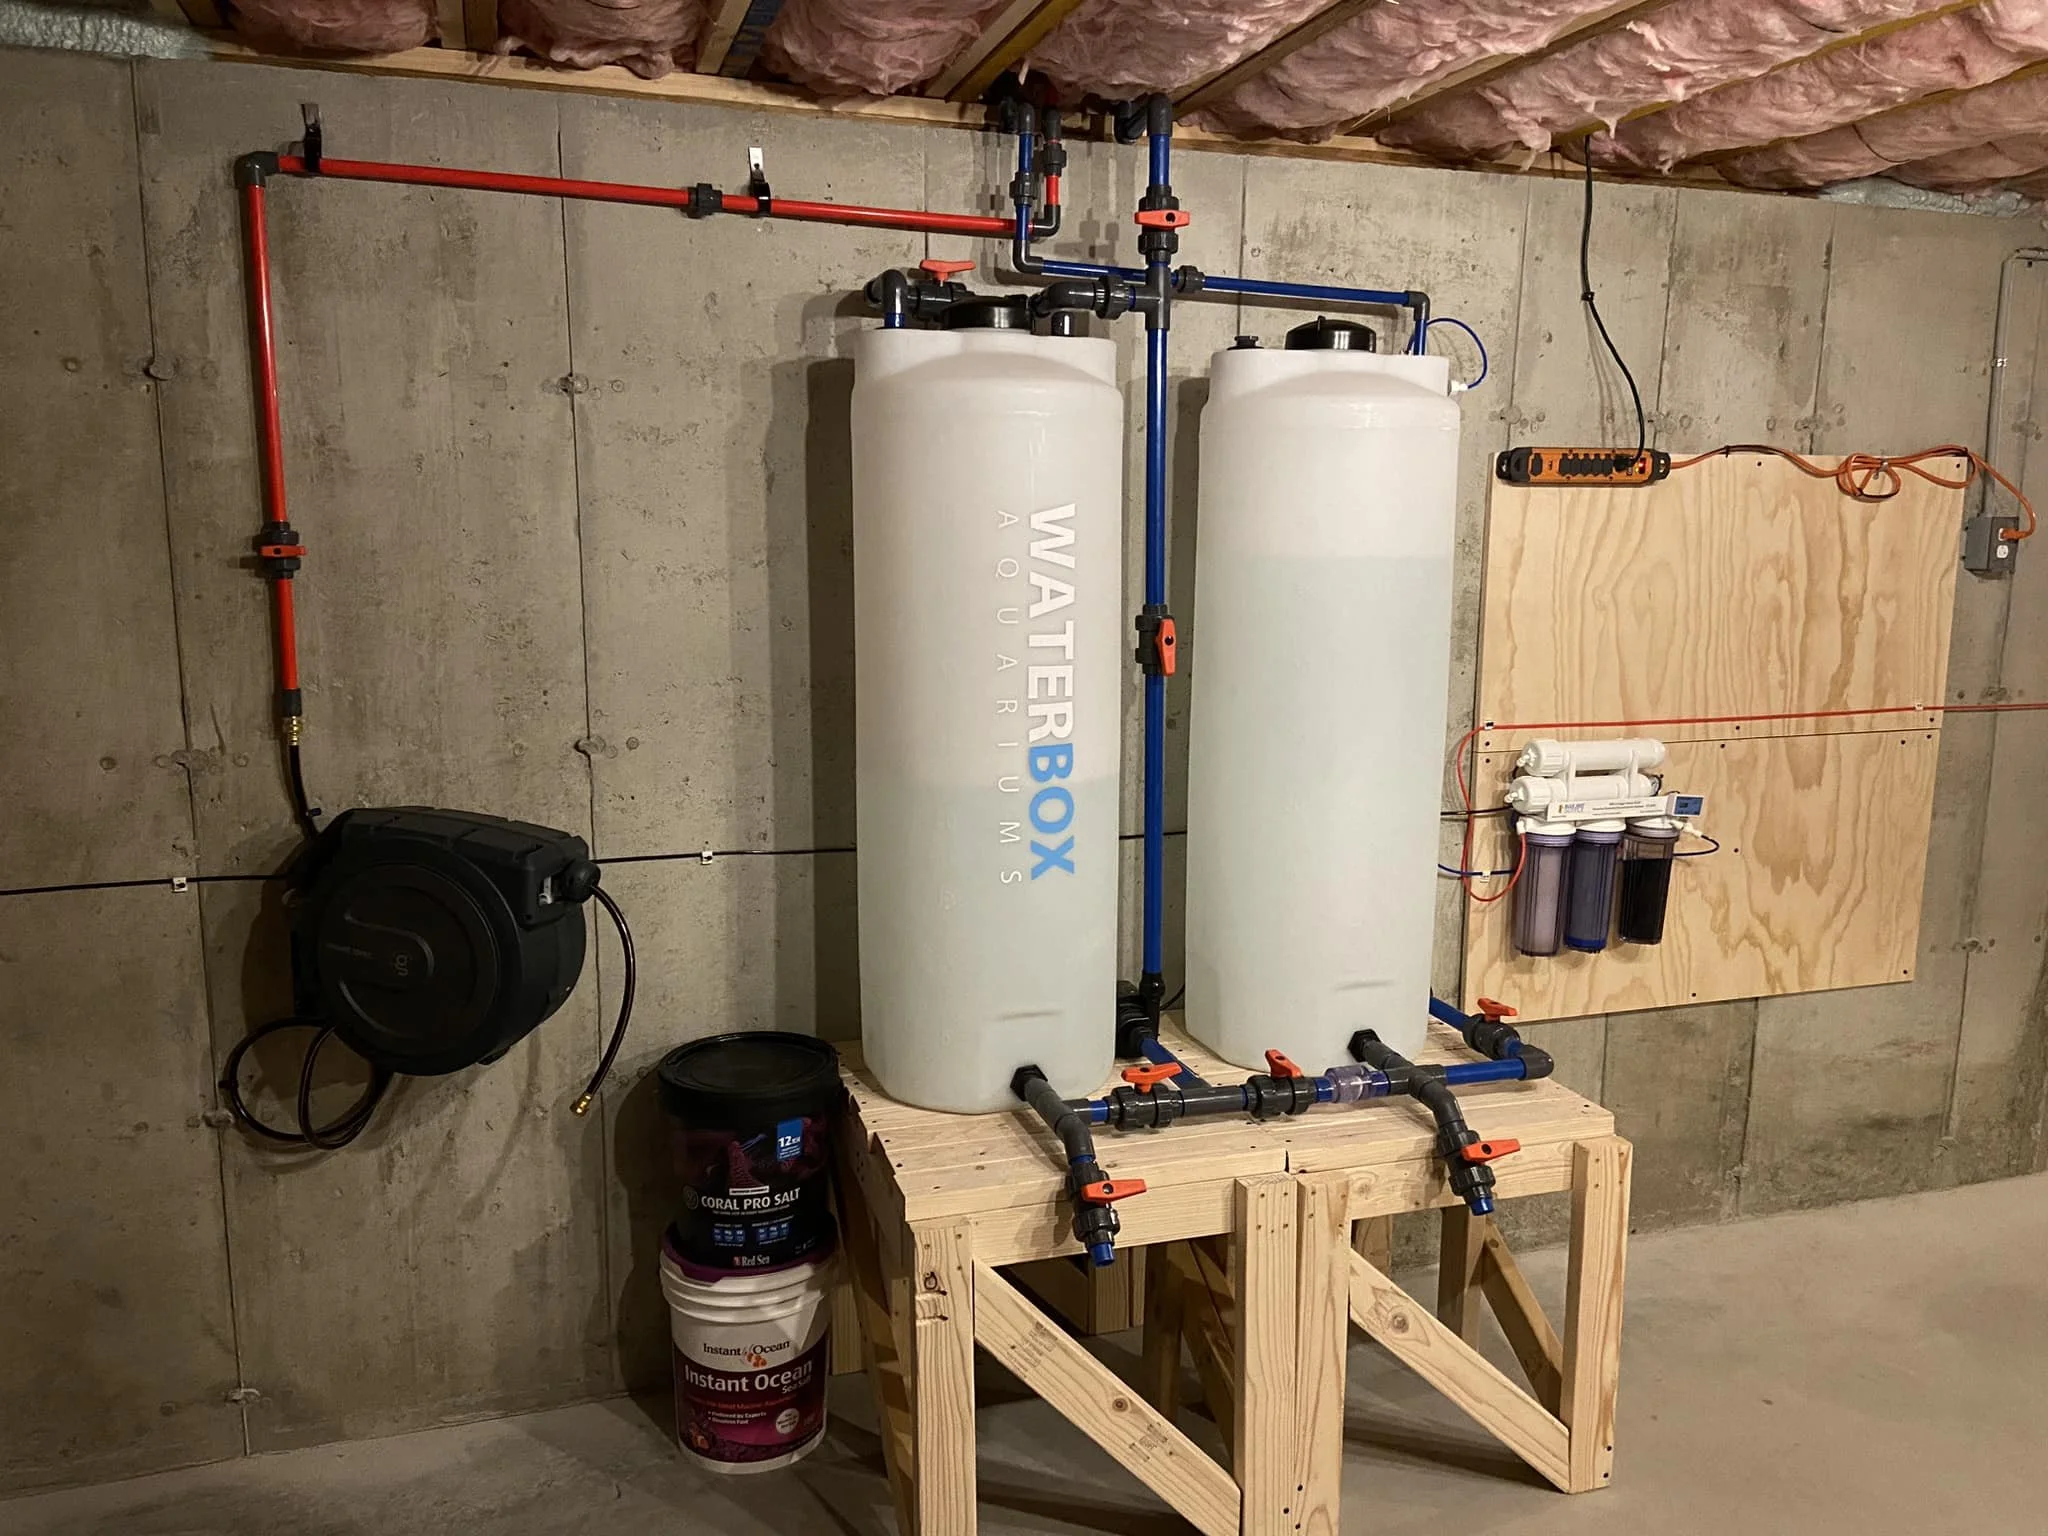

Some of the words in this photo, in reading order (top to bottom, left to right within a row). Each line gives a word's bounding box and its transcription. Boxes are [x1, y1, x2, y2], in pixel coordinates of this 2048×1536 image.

[995, 510, 1022, 884] AQUARIUMS
[1027, 503, 1076, 881] WATERBOX
[700, 1195, 740, 1211] CORAL
[743, 1196, 771, 1210] PRO
[774, 1187, 801, 1206] SALT
[742, 1255, 756, 1267] Red
[757, 1254, 770, 1265] Sea
[703, 1343, 742, 1356] Instant
[752, 1340, 790, 1354] Ocean
[684, 1363, 751, 1393] Instant
[754, 1360, 813, 1391] Ocean
